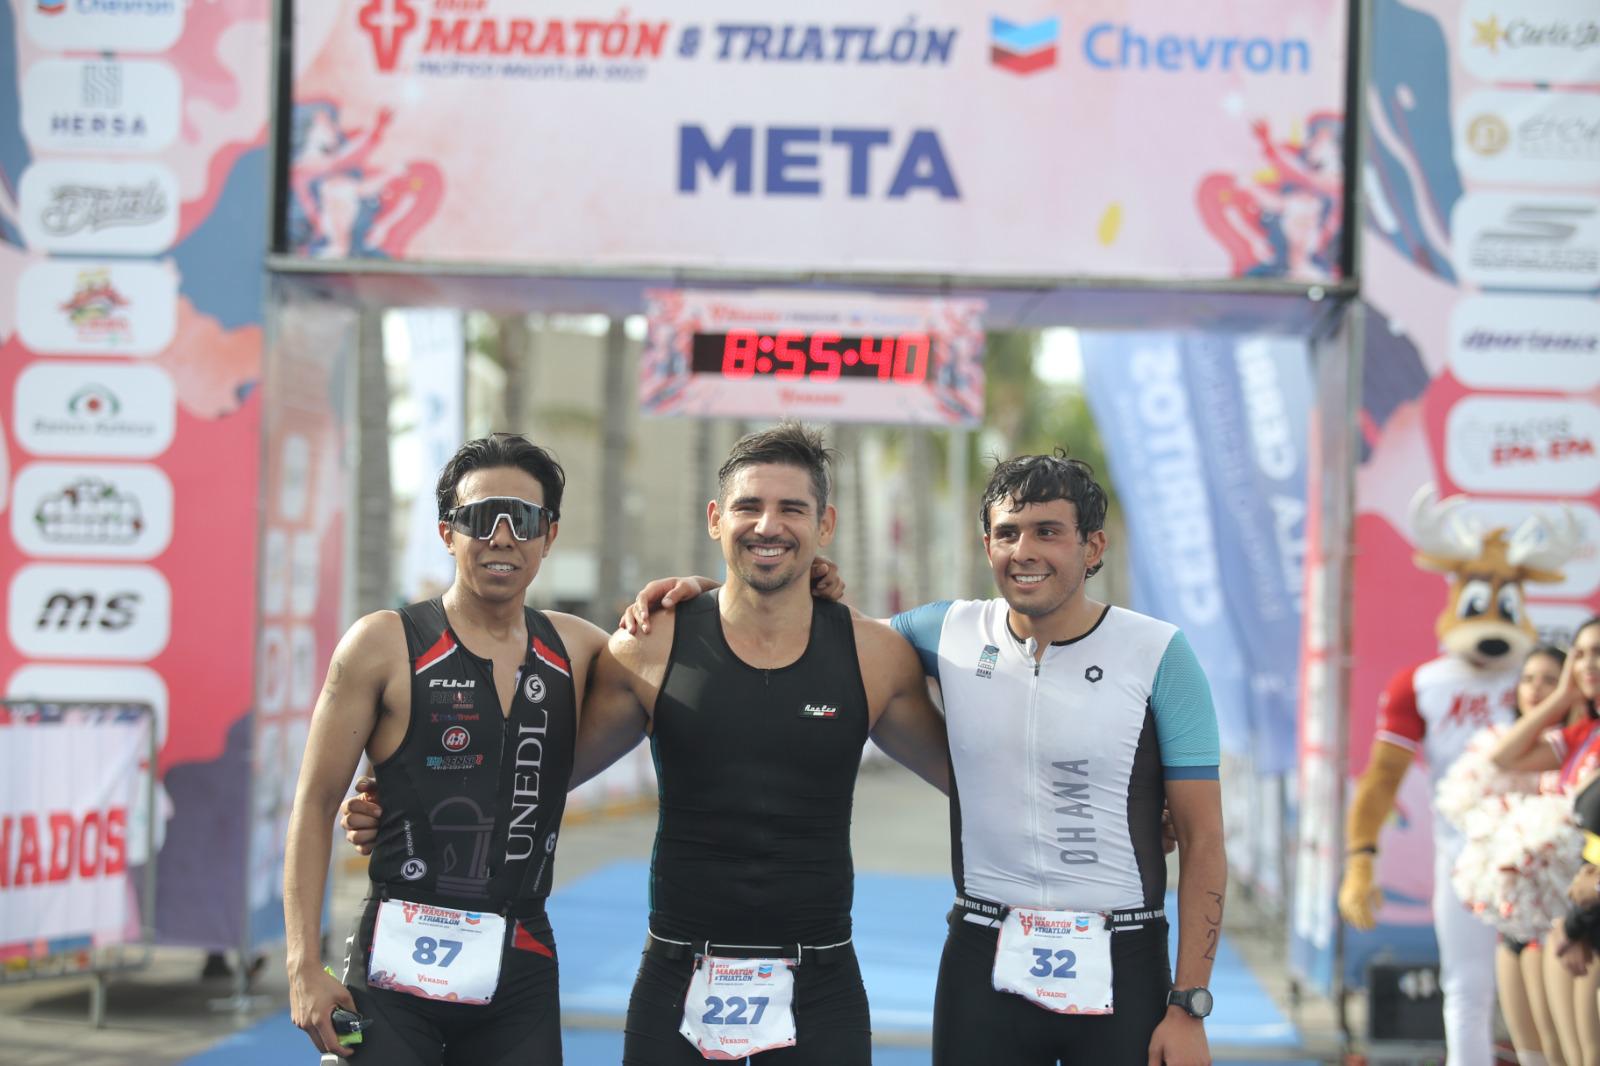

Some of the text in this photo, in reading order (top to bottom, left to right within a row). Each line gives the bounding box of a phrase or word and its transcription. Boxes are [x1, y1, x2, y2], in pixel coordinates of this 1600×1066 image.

[423, 7, 670, 57] MARATÓN
[714, 15, 958, 65] TRIATLÓN
[1082, 23, 1310, 73] Chevron
[51, 115, 147, 135] HERSA
[677, 125, 963, 200] META
[429, 679, 475, 688] FUJI
[505, 709, 548, 864] UNEDL
[1052, 759, 1099, 865] OHANA
[965, 900, 980, 911] BIKE
[982, 905, 998, 915] RUN
[412, 936, 463, 968] 87
[1029, 948, 1076, 979] 32
[702, 996, 770, 1025] 227
